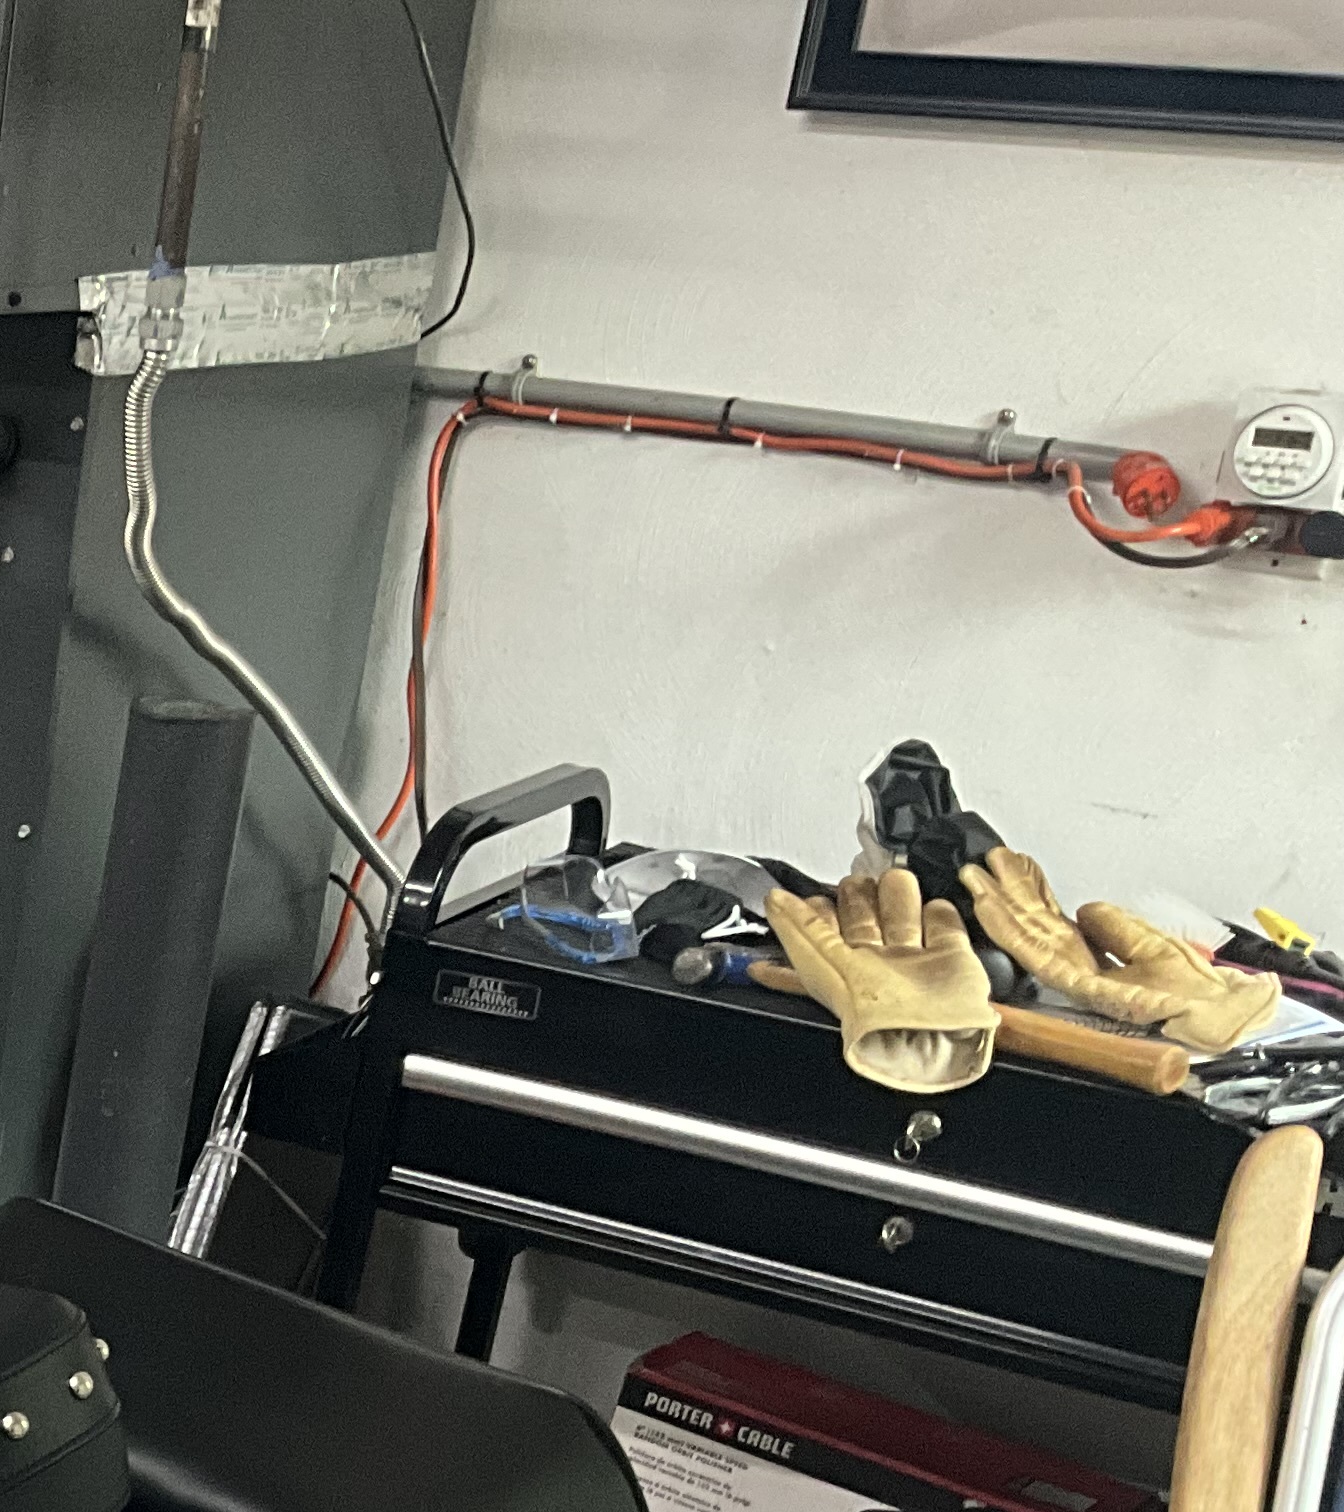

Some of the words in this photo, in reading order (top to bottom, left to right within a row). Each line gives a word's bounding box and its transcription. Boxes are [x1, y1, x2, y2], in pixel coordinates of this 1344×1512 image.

[452, 985, 519, 1010] BEARING
[469, 976, 506, 995] BALL
[643, 1391, 714, 1430] PORTER
[736, 1425, 796, 1460] CABLE
